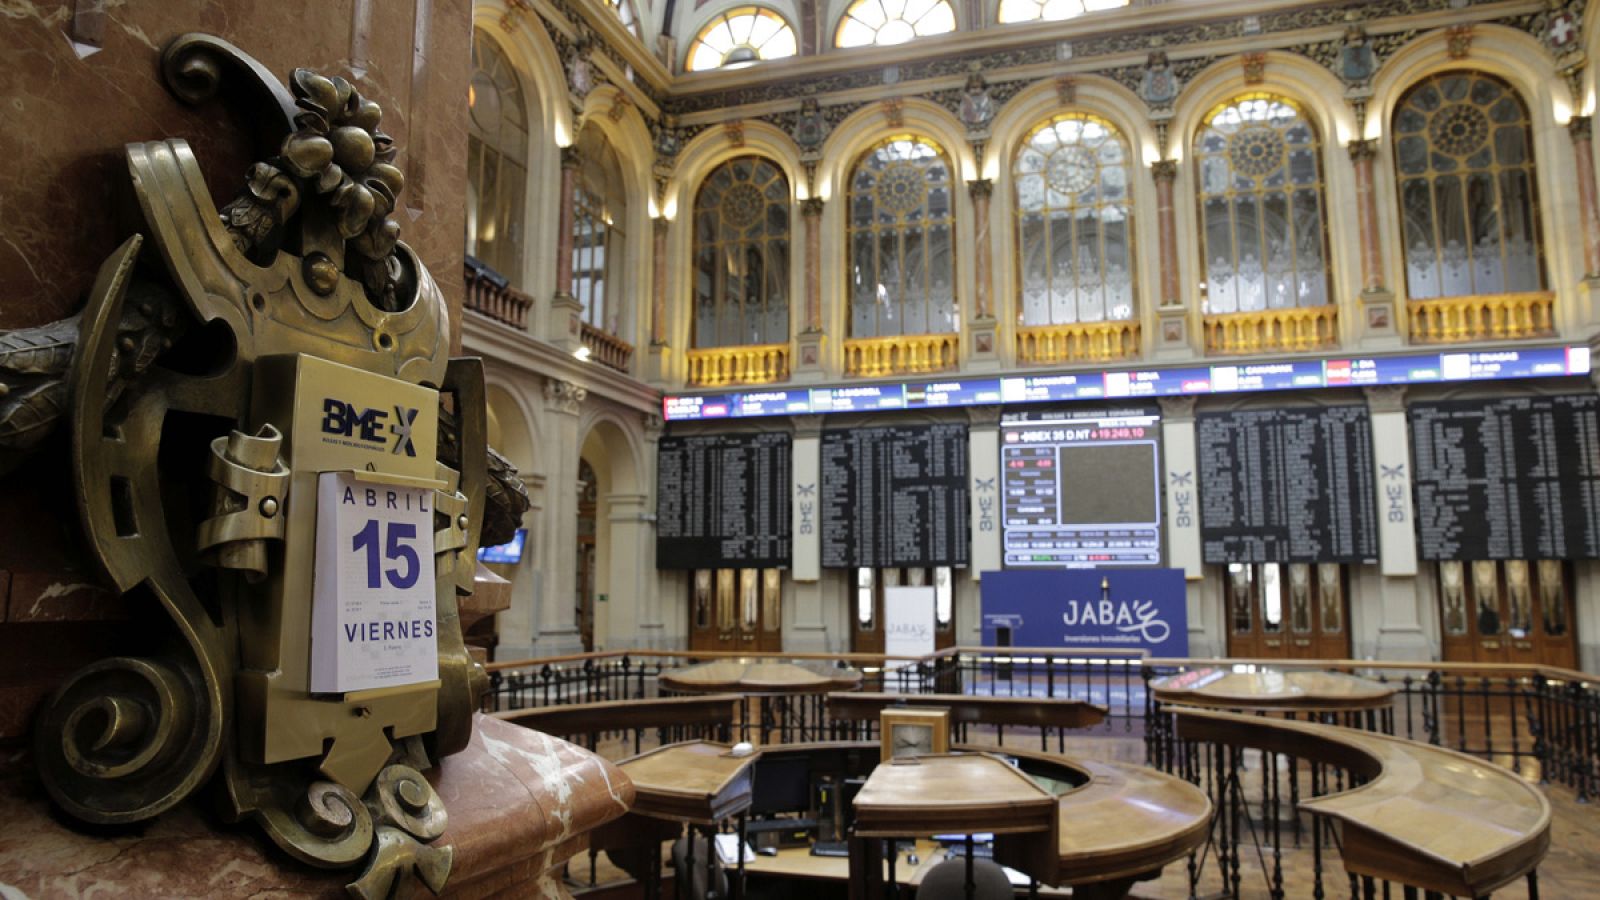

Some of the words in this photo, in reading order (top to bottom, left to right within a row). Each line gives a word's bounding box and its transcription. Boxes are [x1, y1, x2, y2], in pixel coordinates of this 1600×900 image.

[343, 486, 428, 513] ABRIL
[352, 519, 421, 590] 15
[344, 619, 433, 643] VIERNES
